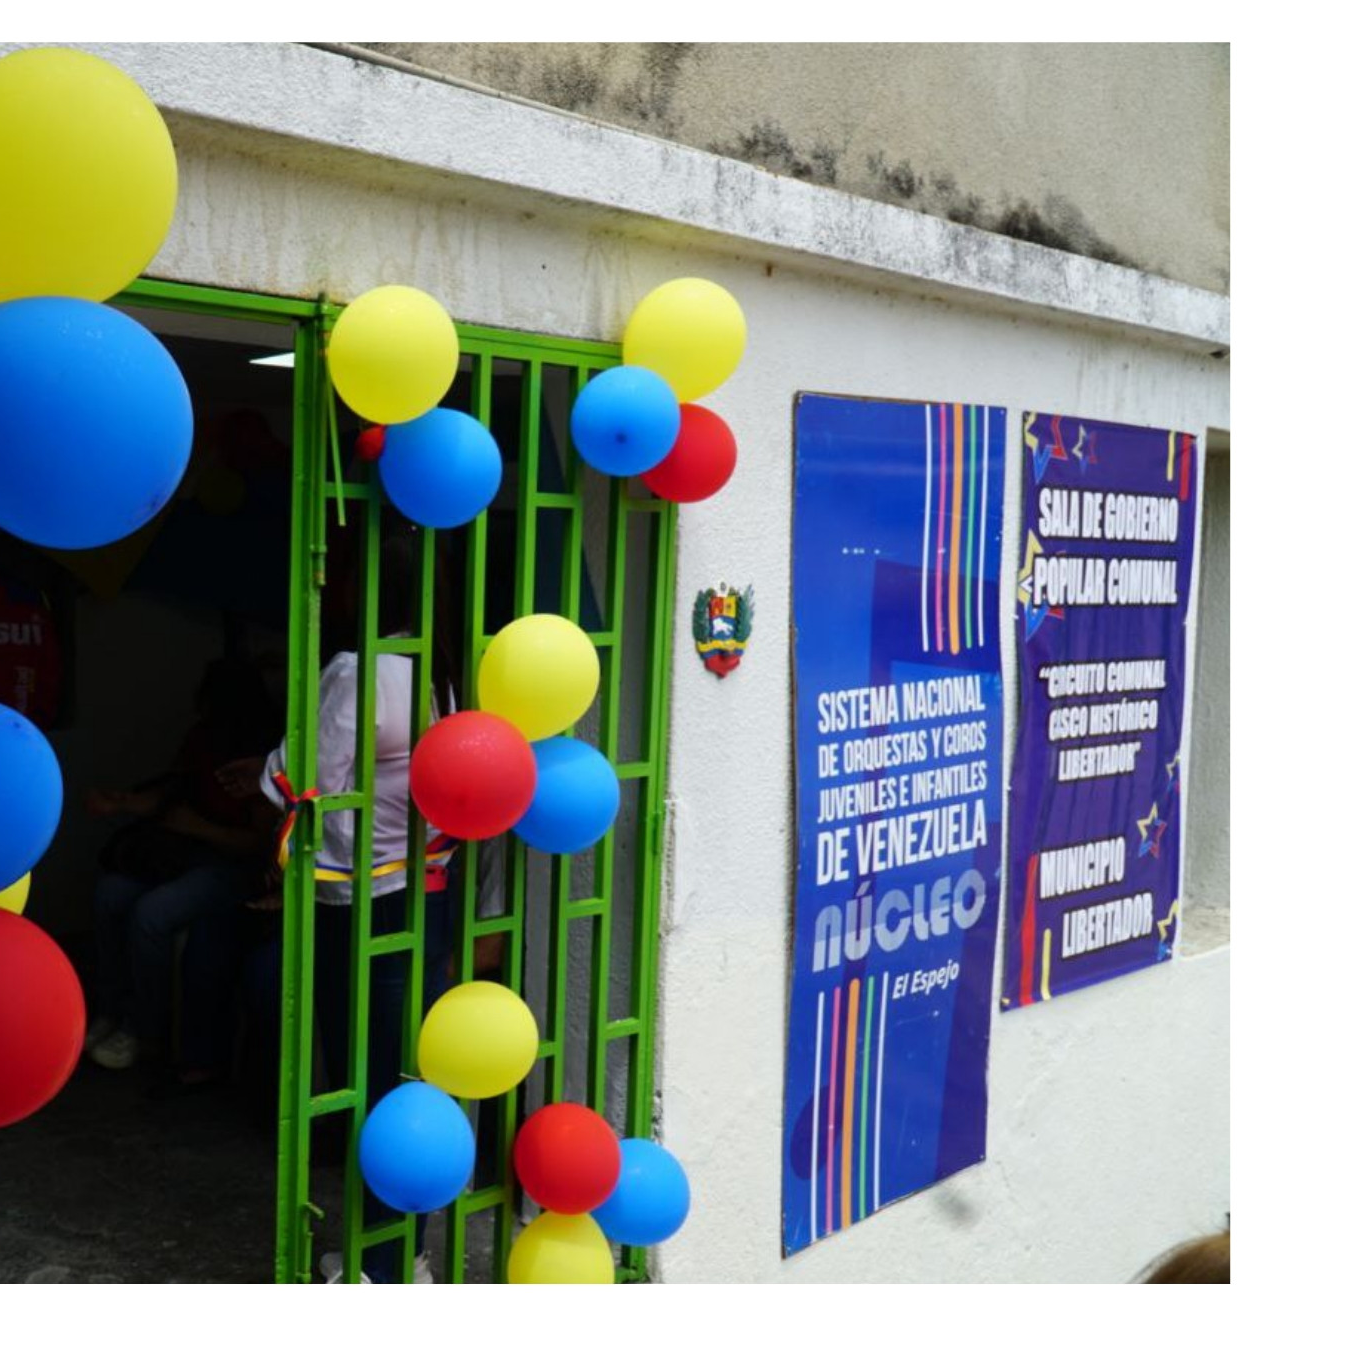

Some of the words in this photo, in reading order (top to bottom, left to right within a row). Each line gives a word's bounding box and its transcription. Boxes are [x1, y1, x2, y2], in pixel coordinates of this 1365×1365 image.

[1038, 487, 1080, 537] SALA
[1081, 491, 1103, 538] DE
[1104, 492, 1179, 543] GOBIERNO
[1033, 556, 1106, 606] POPULAR
[1107, 558, 1178, 605] COMUNAL
[818, 684, 899, 734] SISTEMA
[902, 674, 986, 722] NACIONAL
[1106, 659, 1166, 692] COMUNAL
[1089, 697, 1158, 735] HISTÓRICO
[818, 742, 840, 779] DE
[843, 729, 928, 774] ORQUESTAS
[930, 726, 943, 759] Y
[943, 720, 987, 757] COROS
[817, 776, 897, 824] JUVENILES
[899, 774, 910, 807] E
[912, 760, 987, 805] INFANTILES
[817, 827, 851, 887] DE
[855, 798, 988, 877] VENEZUELA
[1040, 836, 1126, 899] MUNICIPIO
[812, 868, 987, 973] NÚCLEO
[1062, 892, 1154, 959] LIBERTADOR
[892, 971, 910, 1000] El
[910, 958, 961, 996] Espejo
